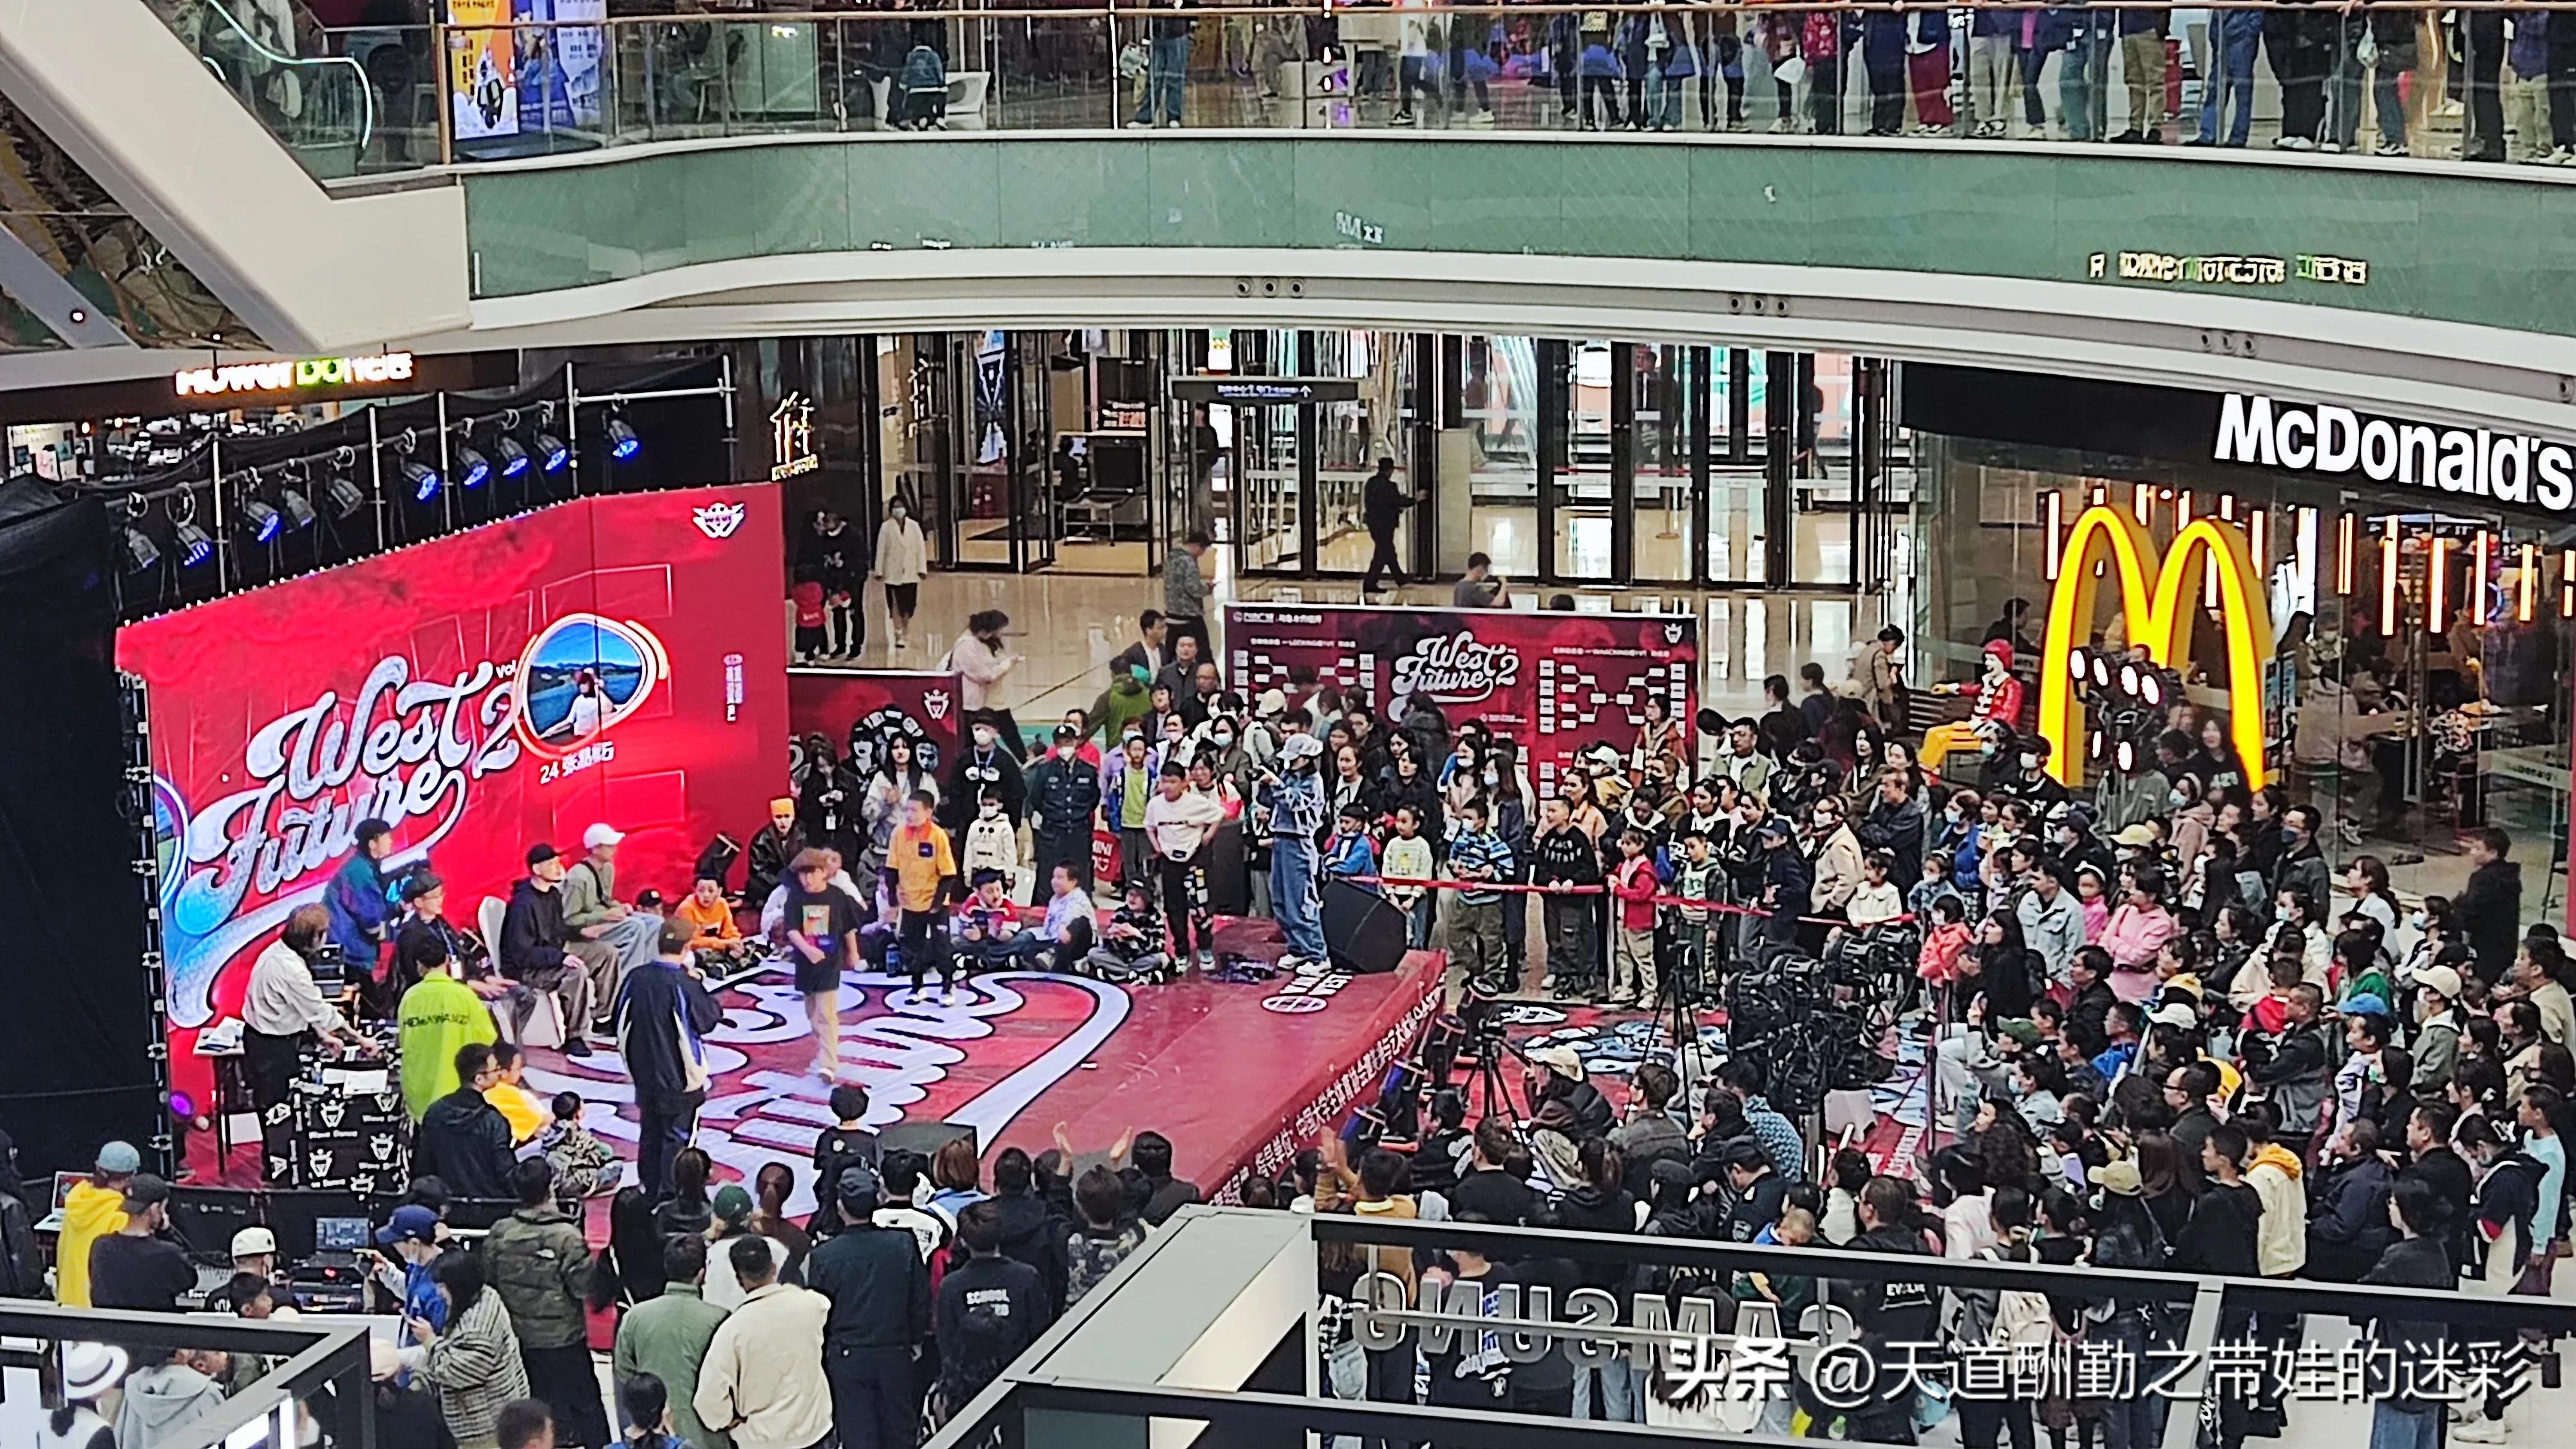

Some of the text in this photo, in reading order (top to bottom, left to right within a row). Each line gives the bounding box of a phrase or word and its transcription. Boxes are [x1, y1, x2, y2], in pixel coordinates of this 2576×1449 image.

[2213, 393, 2574, 511] McDonald's
[1391, 656, 1493, 702] Future
[1416, 630, 1519, 685] West 2
[246, 655, 493, 799] West
[474, 679, 519, 779] 2
[174, 763, 464, 954] Future
